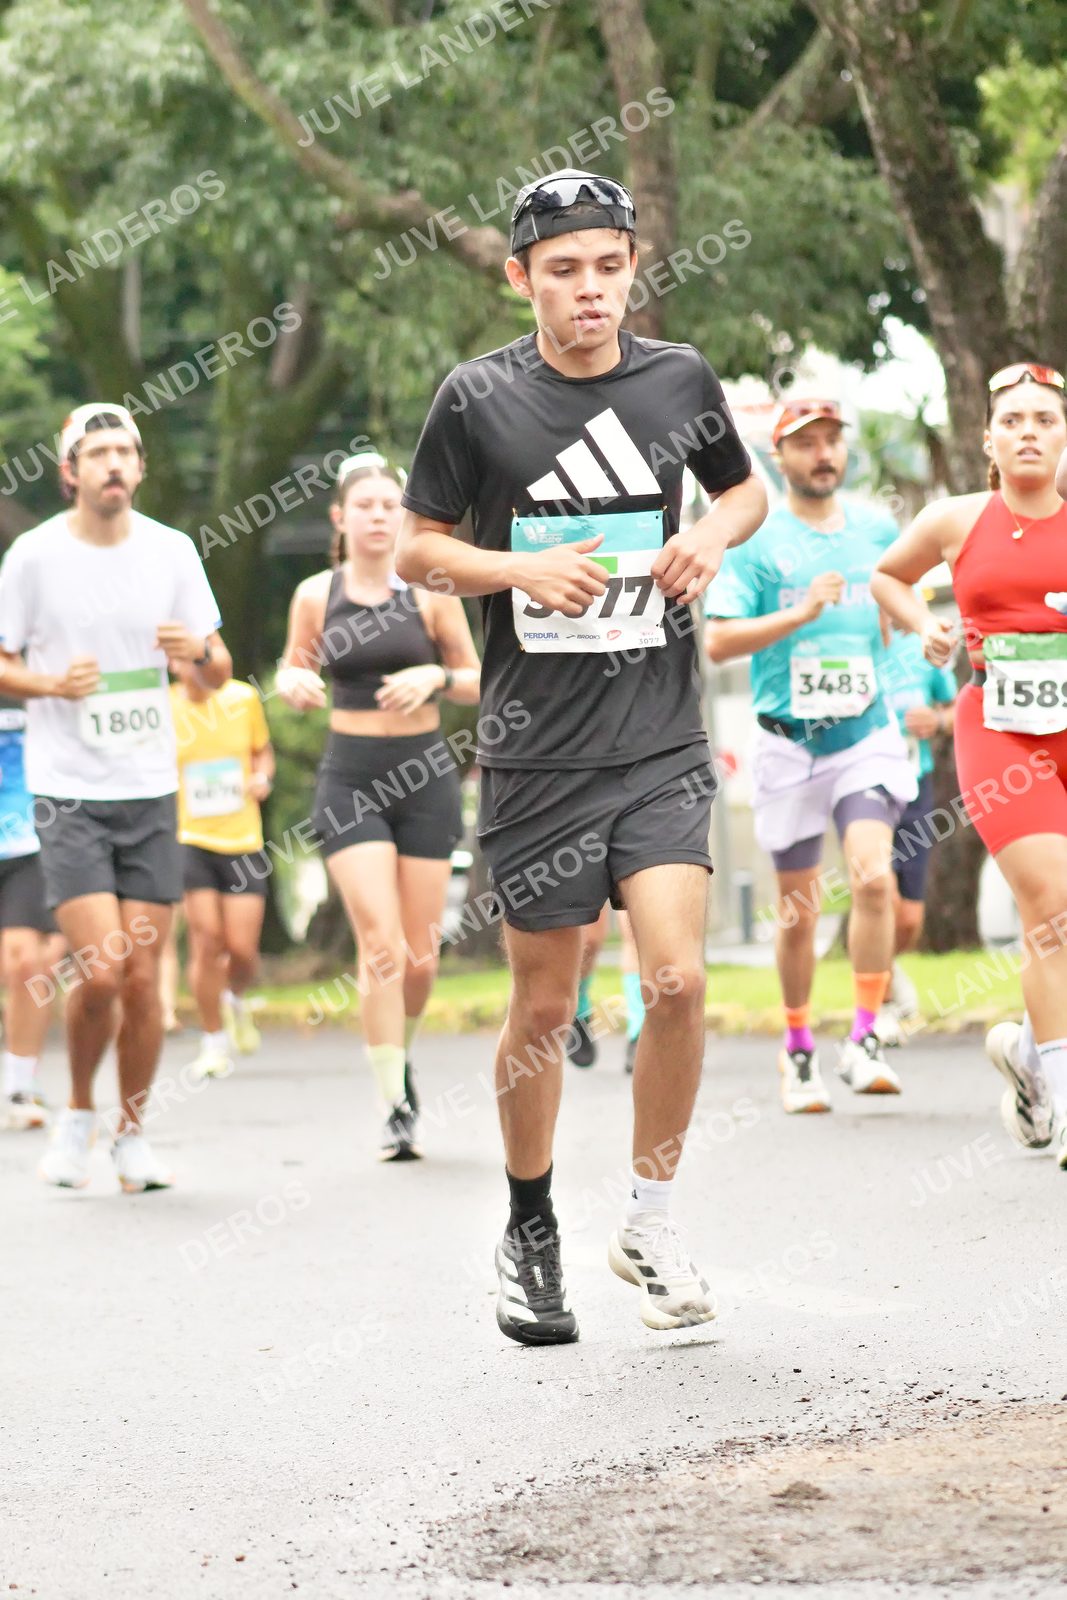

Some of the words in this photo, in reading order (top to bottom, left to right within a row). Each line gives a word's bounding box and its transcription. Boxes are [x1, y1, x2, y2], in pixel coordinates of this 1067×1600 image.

[799, 673, 869, 695] 3483
[996, 679, 1067, 708] 158
[90, 706, 160, 735] 1800
